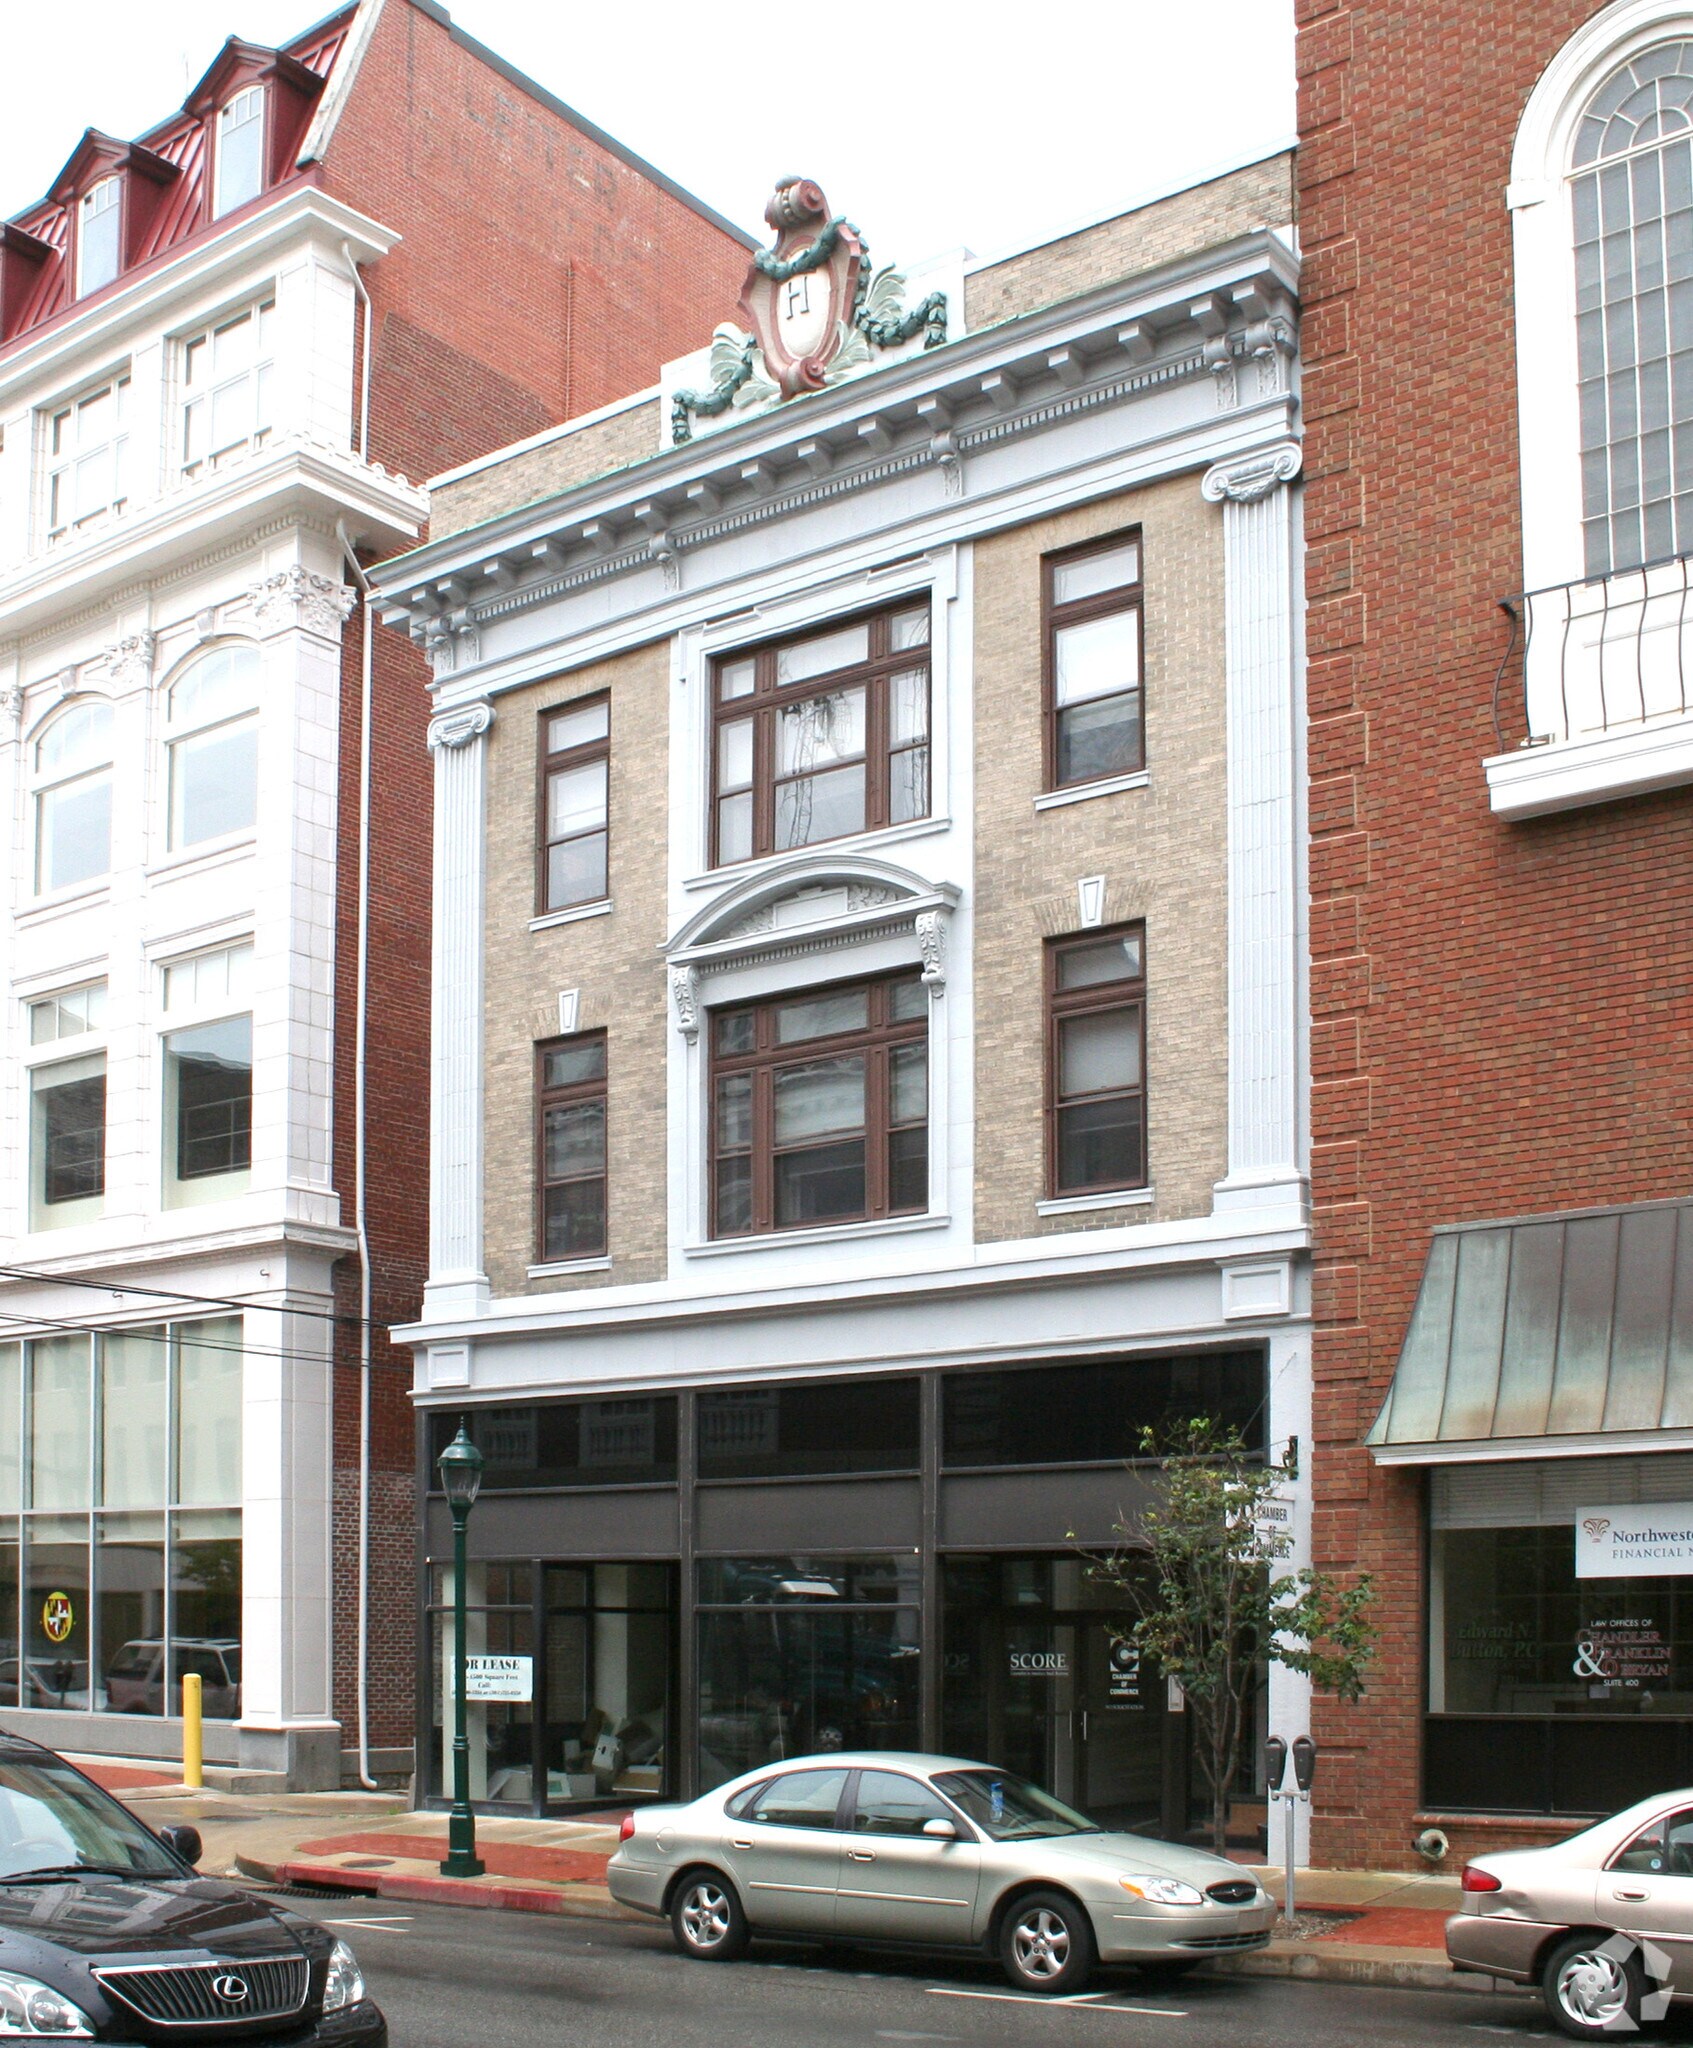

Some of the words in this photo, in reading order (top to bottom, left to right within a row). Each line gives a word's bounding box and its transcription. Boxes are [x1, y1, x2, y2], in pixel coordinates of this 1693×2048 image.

[1257, 1506, 1287, 1521] CHAMBER
[1612, 1528, 1693, 1543] Northwest
[1612, 1547, 1683, 1559] FINANCIAL
[482, 1659, 520, 1670] LEASE
[1010, 1653, 1067, 1669] SCORE
[1573, 1641, 1608, 1677] &
[1603, 1679, 1622, 1687] SUITE
[1625, 1679, 1639, 1687] 400
